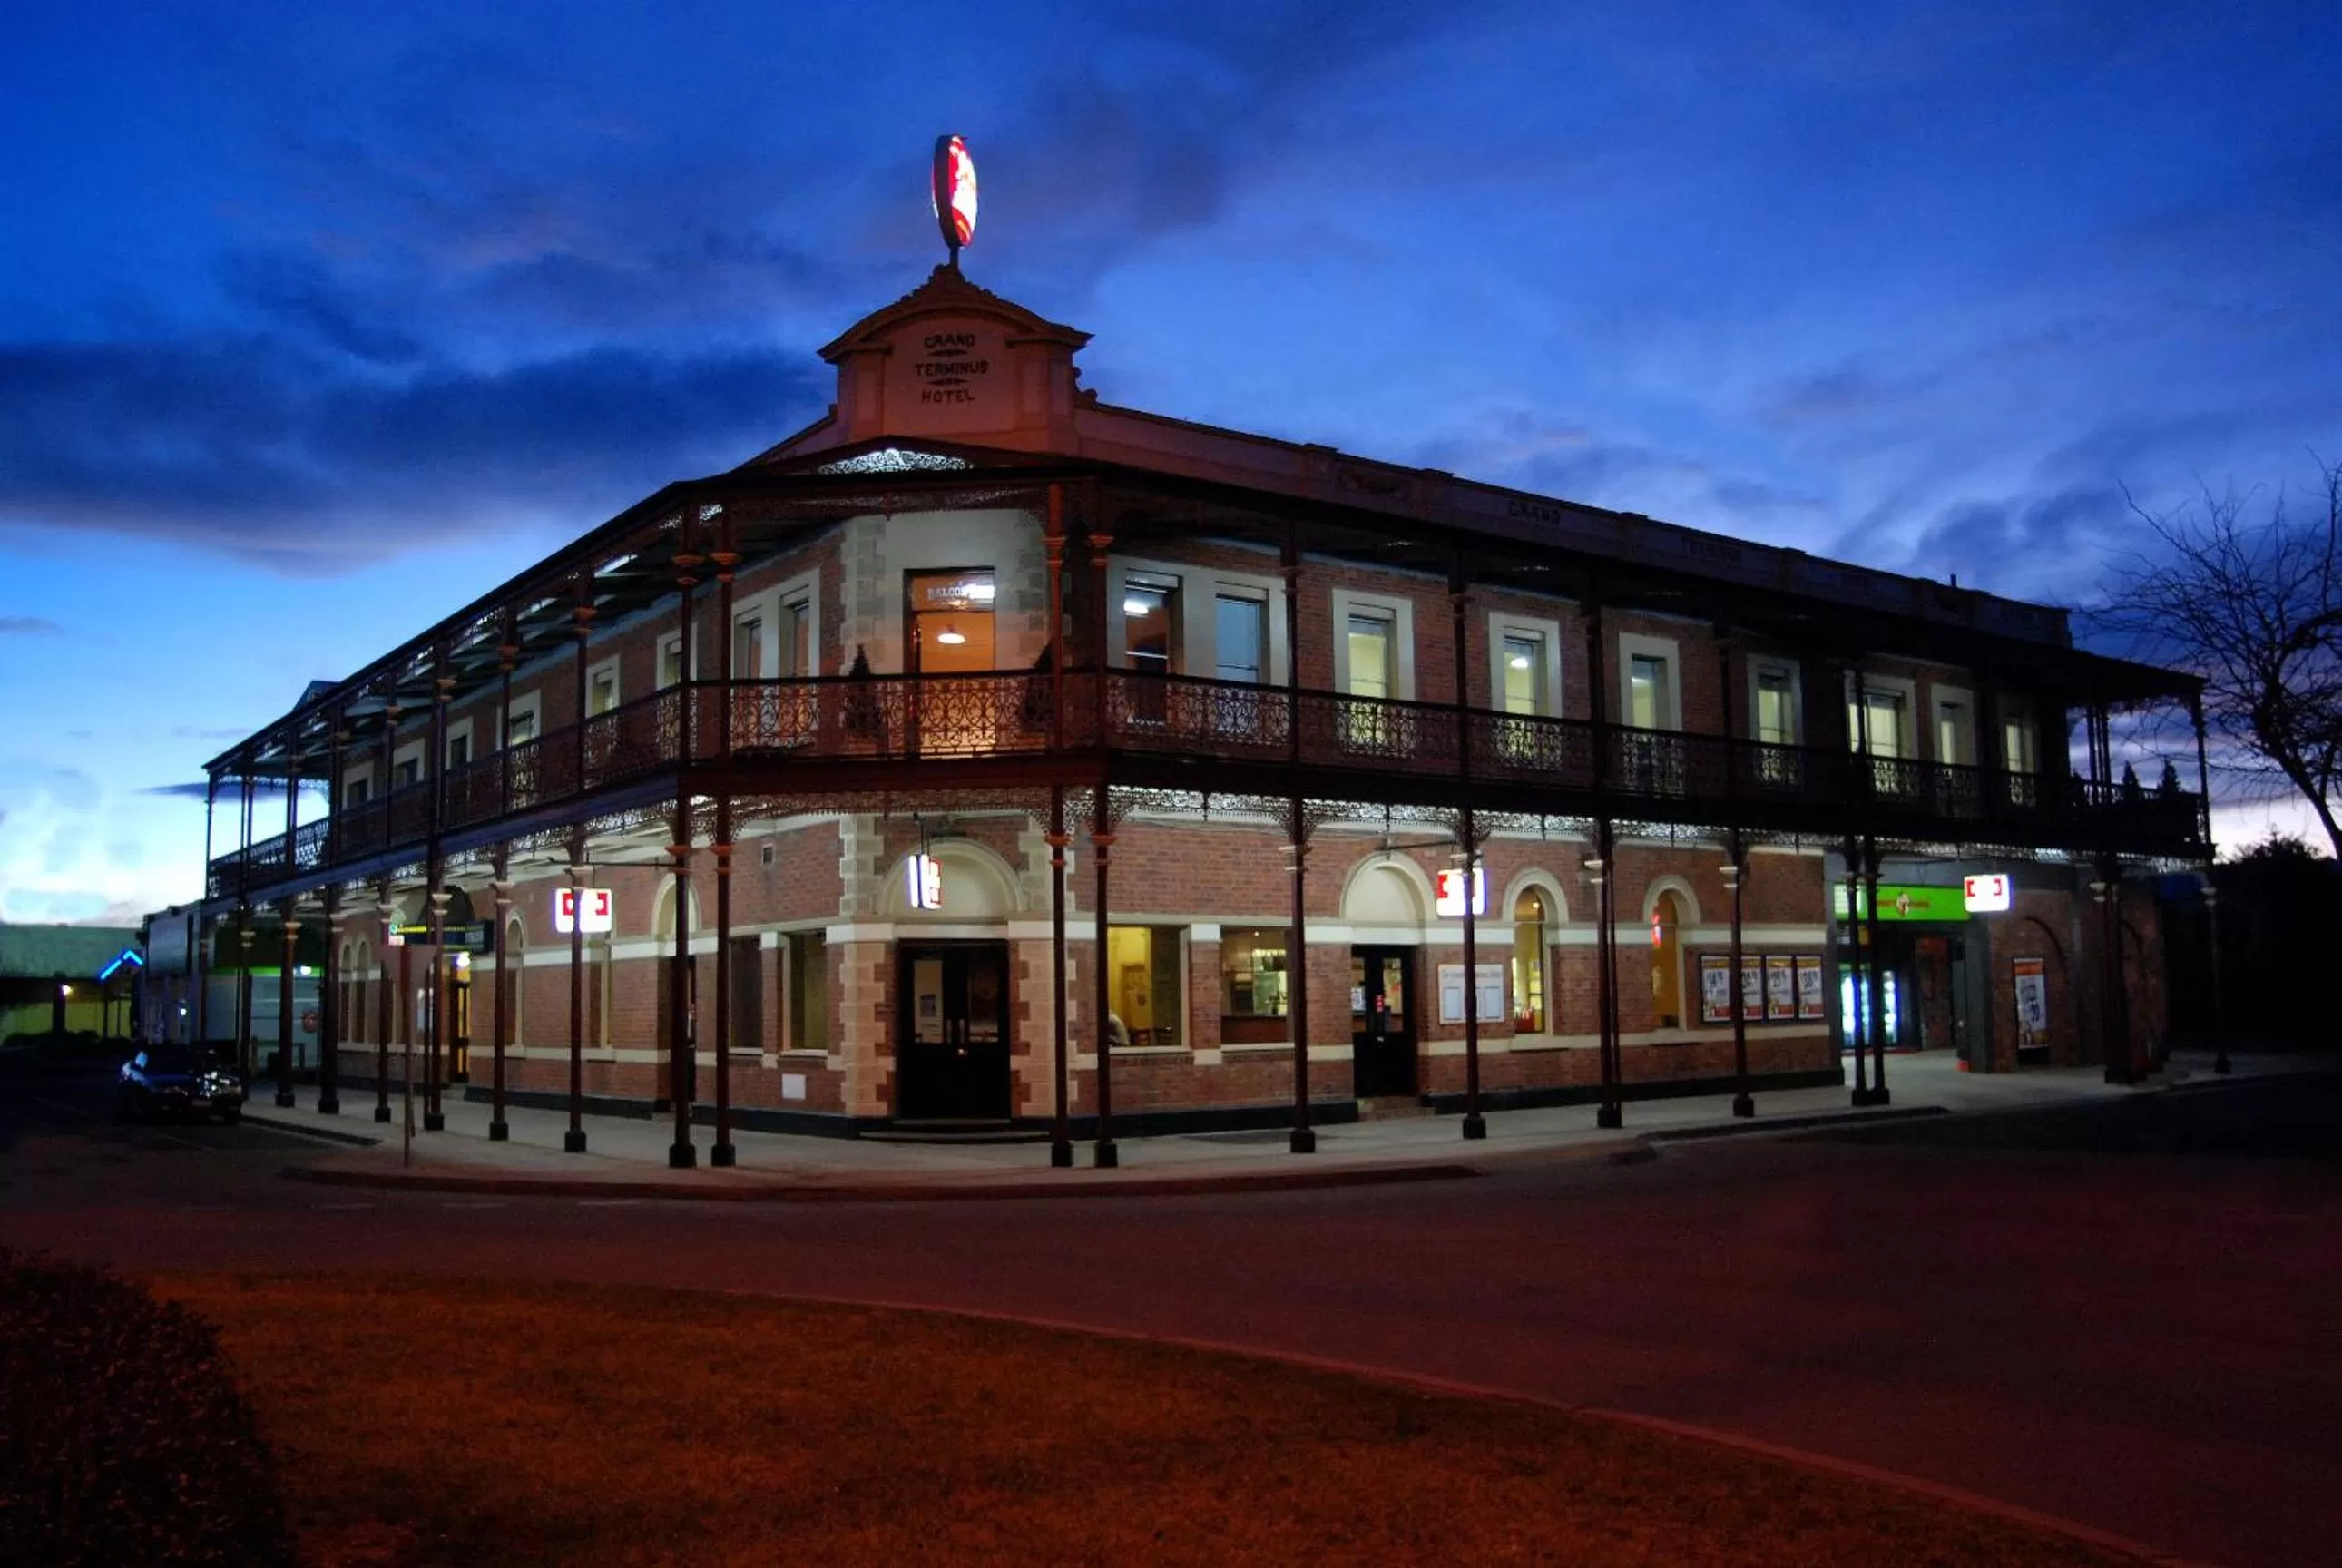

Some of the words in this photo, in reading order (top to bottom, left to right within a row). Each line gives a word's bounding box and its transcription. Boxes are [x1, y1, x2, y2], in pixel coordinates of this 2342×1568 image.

[924, 333, 976, 348] GRAND
[914, 359, 989, 377] TERMINUS
[922, 388, 976, 404] HOTEL
